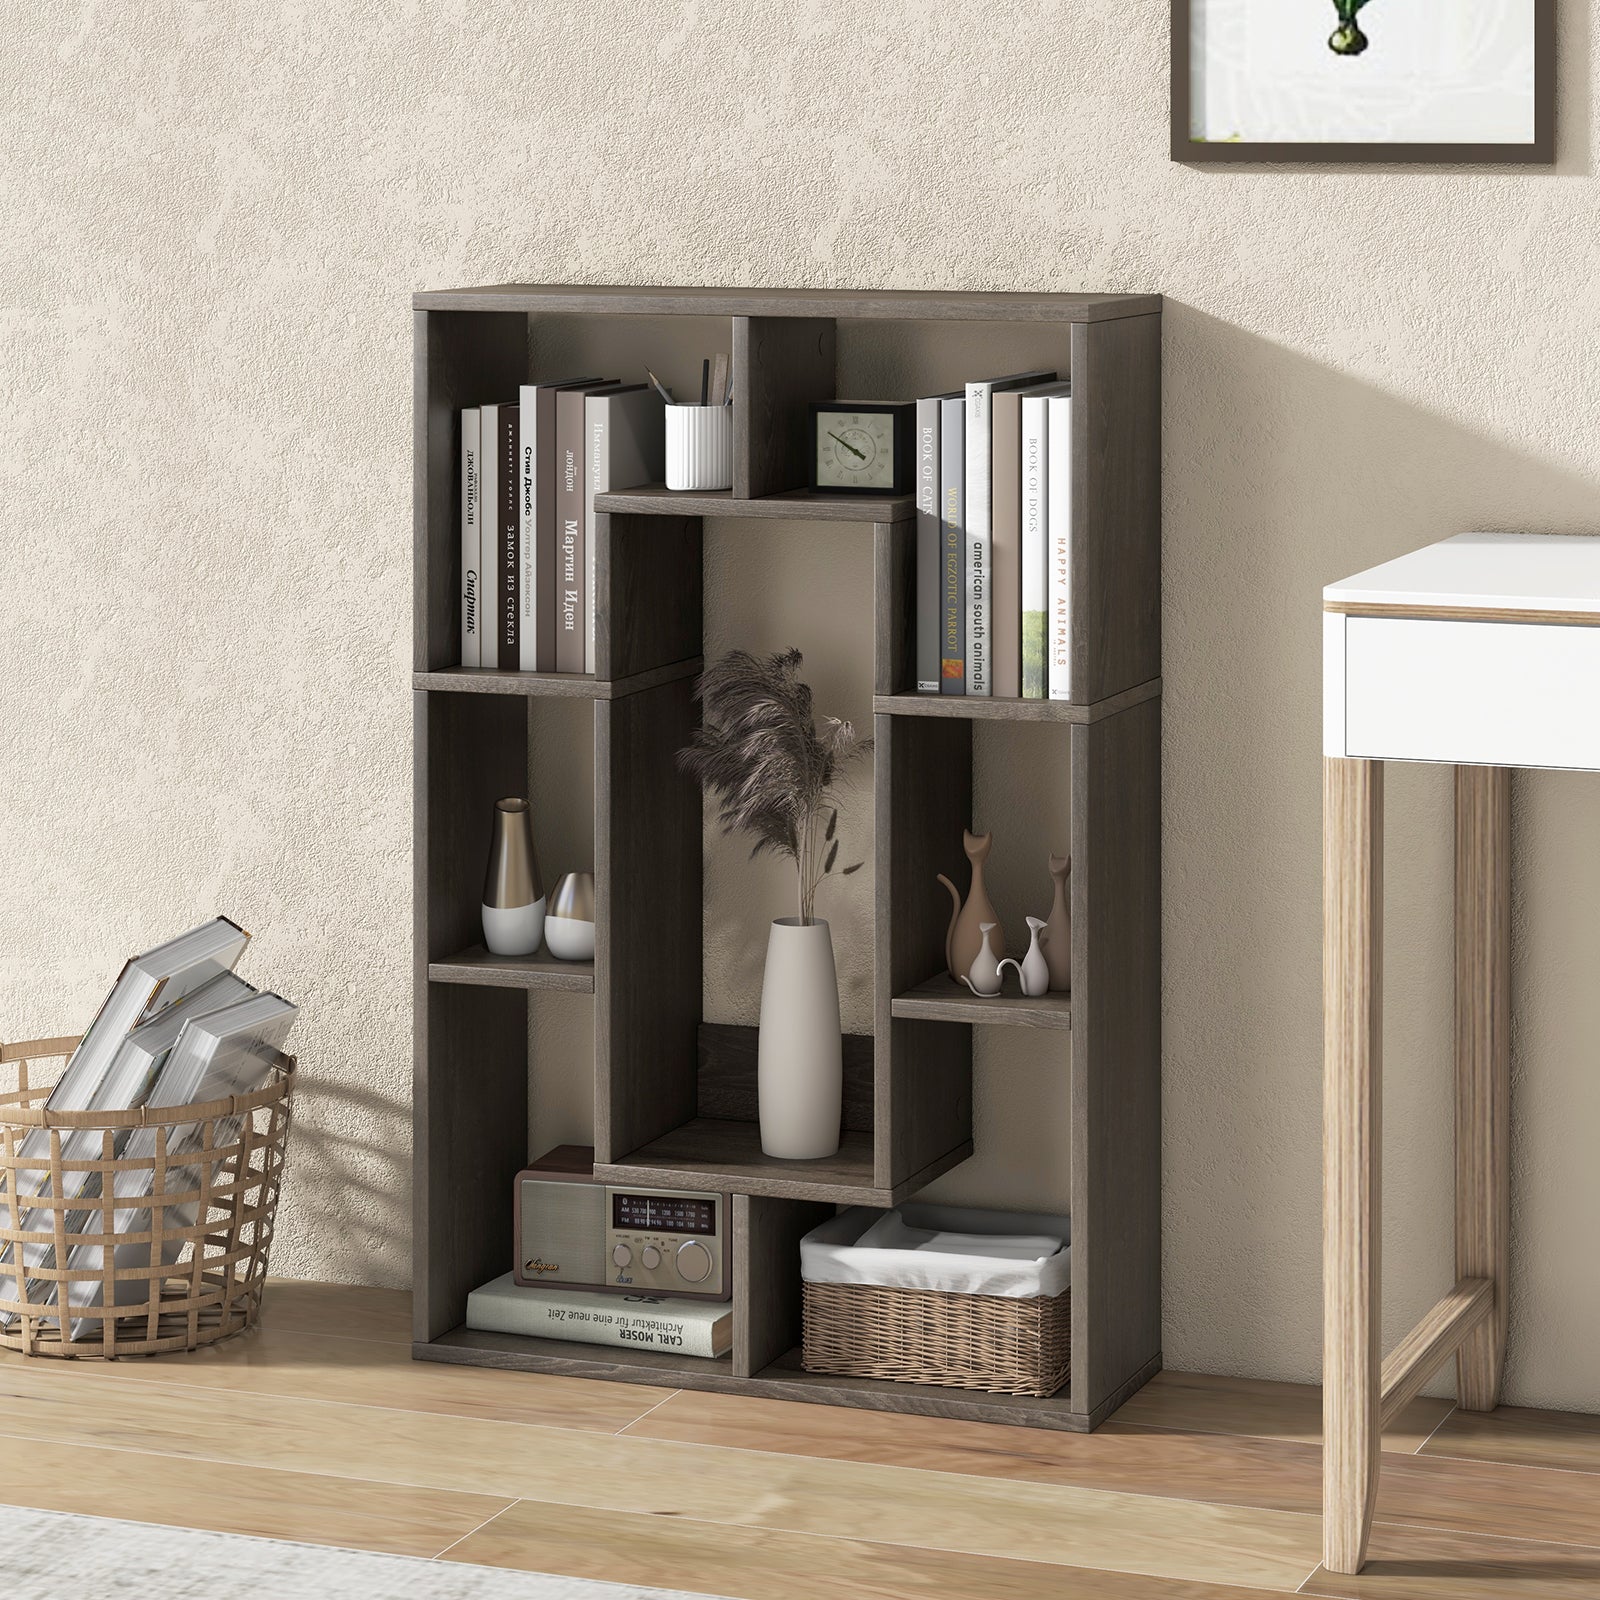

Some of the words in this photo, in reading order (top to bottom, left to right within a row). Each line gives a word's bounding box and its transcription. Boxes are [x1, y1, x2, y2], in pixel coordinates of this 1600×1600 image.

[524, 446, 532, 474] Стив
[922, 427, 932, 461] BOOK
[1028, 438, 1038, 472] BOOK
[466, 449, 475, 525] ДЖОВАНЬОЛИ
[922, 466, 932, 482] OF
[1028, 477, 1038, 492] OF
[523, 477, 532, 517] Джобс
[922, 486, 932, 516] CATS
[947, 487, 957, 529] WORLD
[1028, 498, 1038, 533] DOGS
[563, 519, 578, 582] Мартин
[947, 533, 957, 549] OF
[947, 552, 957, 604] EGZOTIC
[973, 542, 985, 600] american
[1056, 537, 1066, 585] HAPPY
[464, 569, 478, 634] Спартак
[563, 589, 578, 631] Иден
[947, 607, 957, 652] PARROT
[973, 603, 985, 639] south
[1057, 597, 1066, 666] ANIMALS
[973, 642, 985, 691] animals
[547, 1308, 566, 1321] Zeit
[568, 1311, 591, 1322] neue
[593, 1313, 613, 1326] eine
[615, 1317, 629, 1329] für
[631, 1319, 684, 1335] Architektur
[619, 1329, 654, 1342] MOSER
[657, 1333, 683, 1346] CARL
